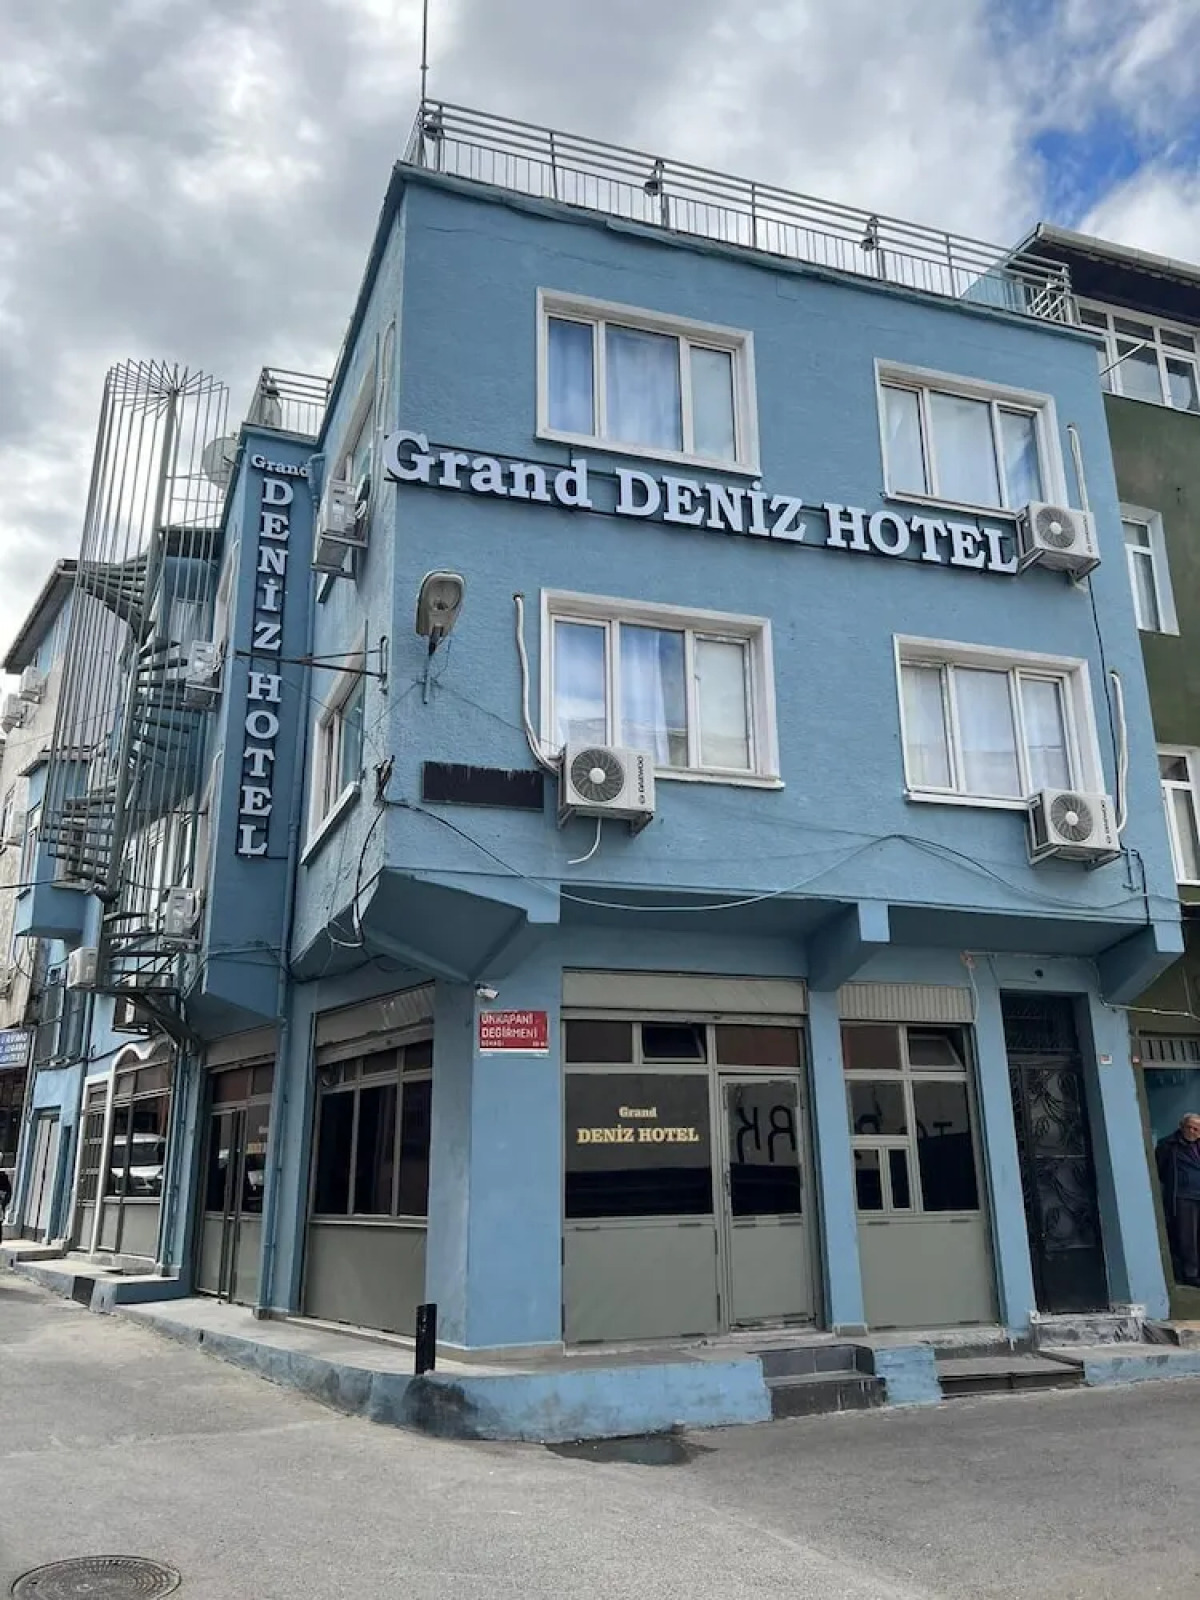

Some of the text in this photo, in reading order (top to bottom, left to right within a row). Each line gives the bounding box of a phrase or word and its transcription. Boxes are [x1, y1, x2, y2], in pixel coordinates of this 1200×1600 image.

[382, 430, 592, 508] Grand
[615, 467, 807, 542] DENİZ
[823, 502, 1018, 574] HOTEL
[238, 671, 282, 857] HOTEL
[577, 1124, 700, 1143] DENİZ HOTEL
[618, 1106, 658, 1118] Grand
